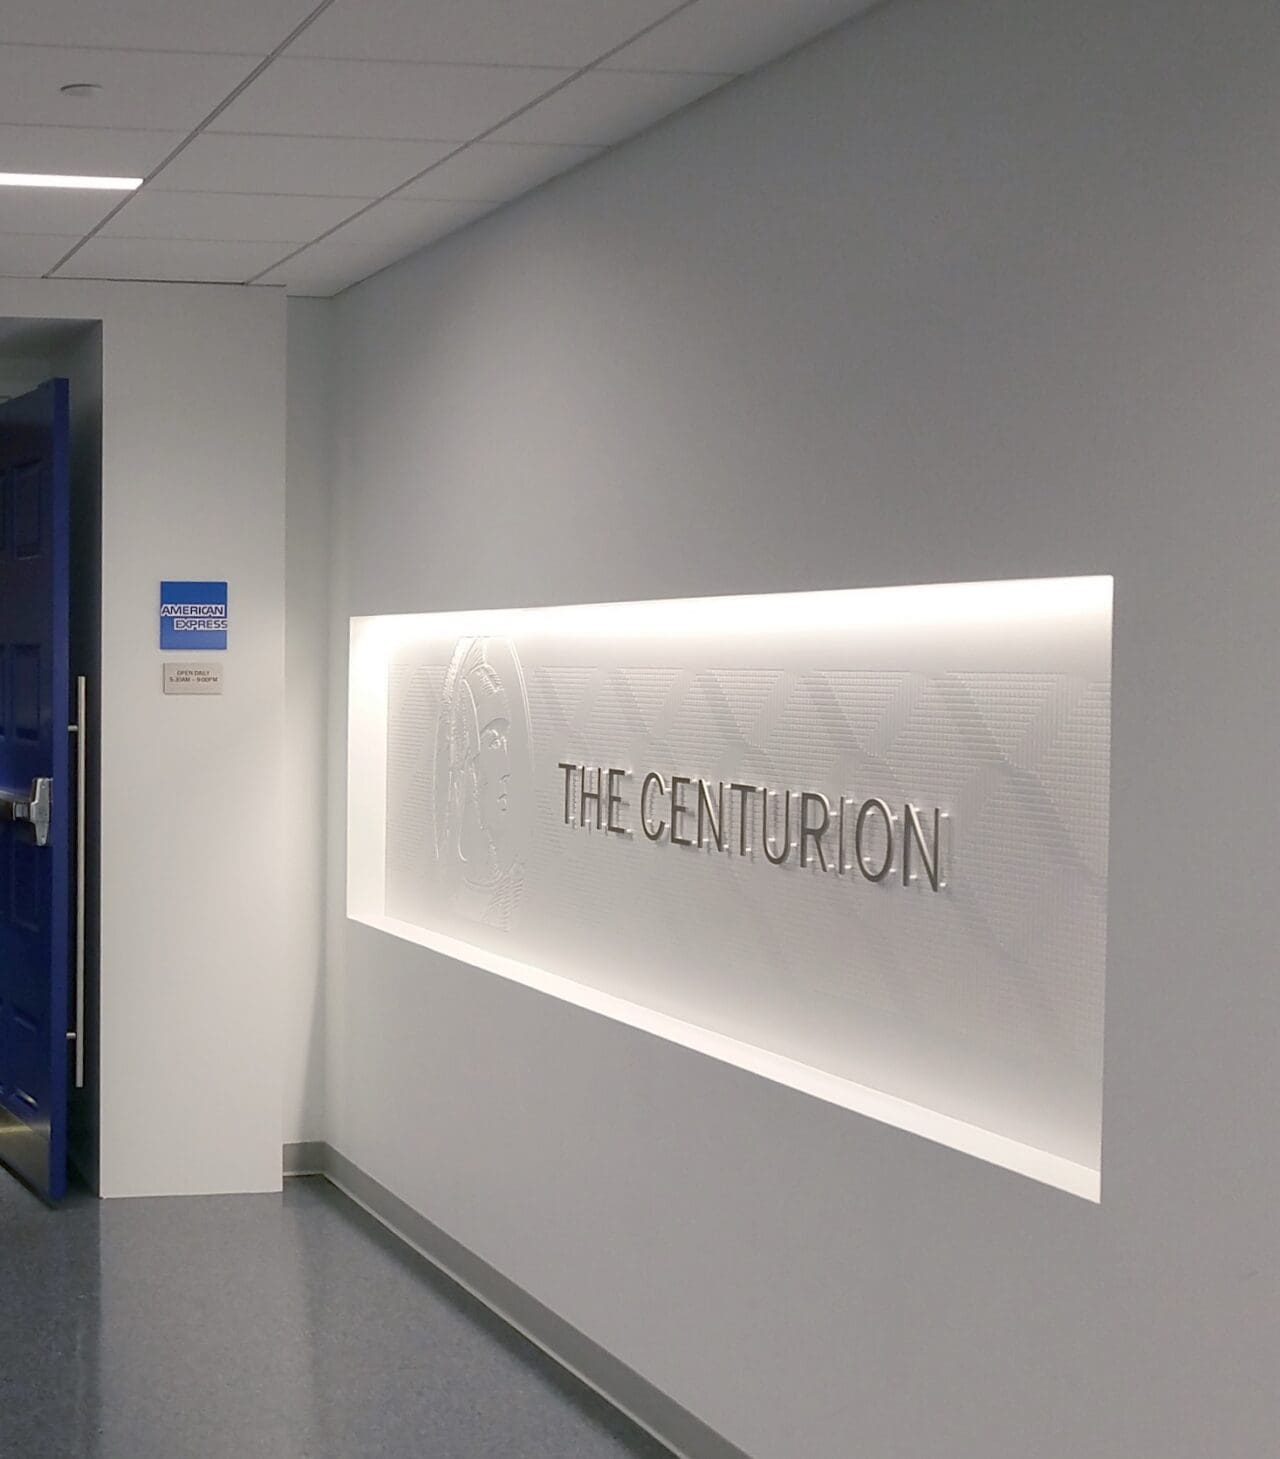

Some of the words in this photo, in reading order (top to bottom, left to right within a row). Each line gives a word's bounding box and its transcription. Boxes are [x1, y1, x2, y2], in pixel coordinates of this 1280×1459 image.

[161, 604, 224, 616] AMERICAN
[175, 619, 228, 630] EXPRESS
[558, 762, 625, 834] THE
[641, 771, 940, 893] CENTURION
